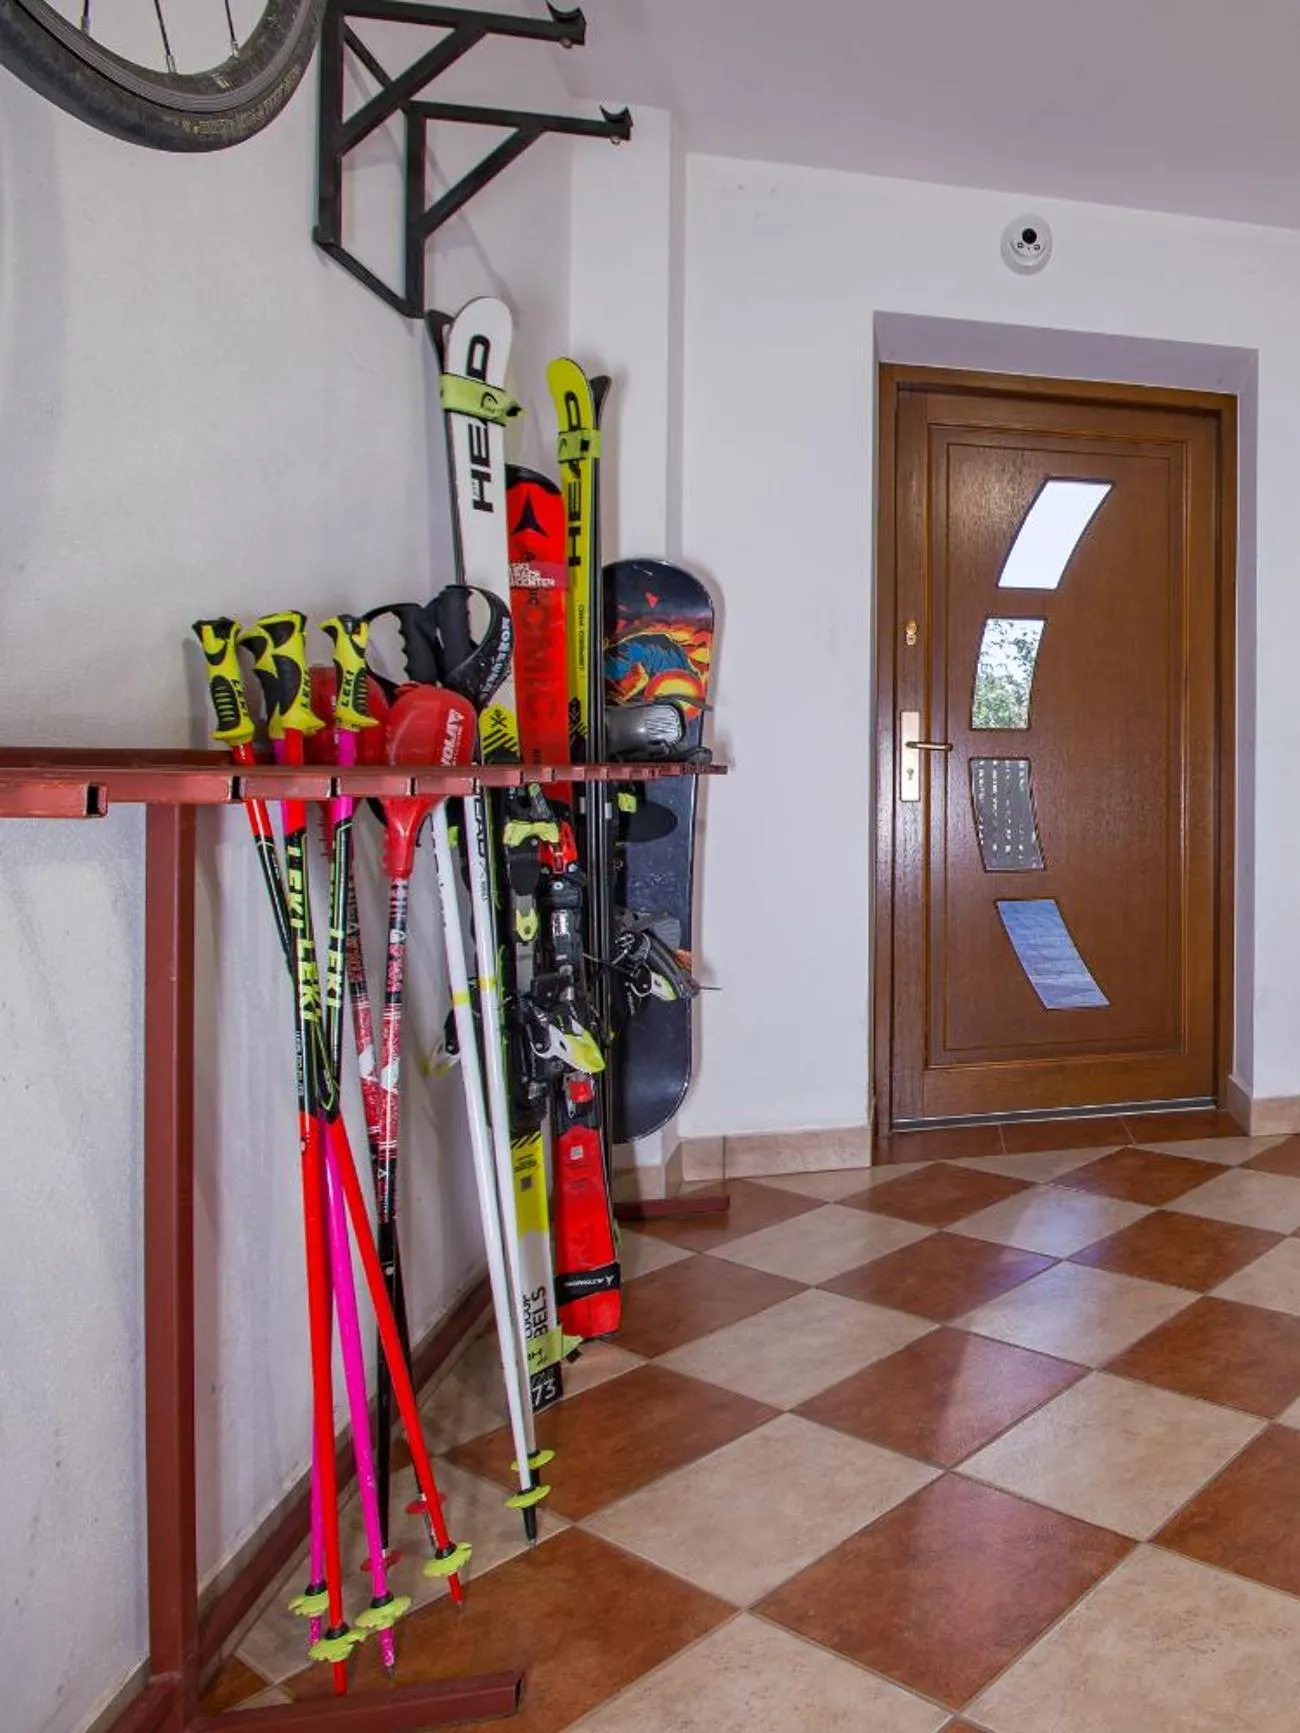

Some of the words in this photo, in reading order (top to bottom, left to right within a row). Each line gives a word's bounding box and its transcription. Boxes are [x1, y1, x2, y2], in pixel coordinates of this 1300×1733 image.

[466, 334, 494, 514] HED
[341, 669, 355, 708] LEKI
[286, 845, 305, 929] LEKI
[297, 938, 321, 1022] LEKI
[326, 927, 347, 1009] LEKI
[531, 1285, 549, 1338] BELS
